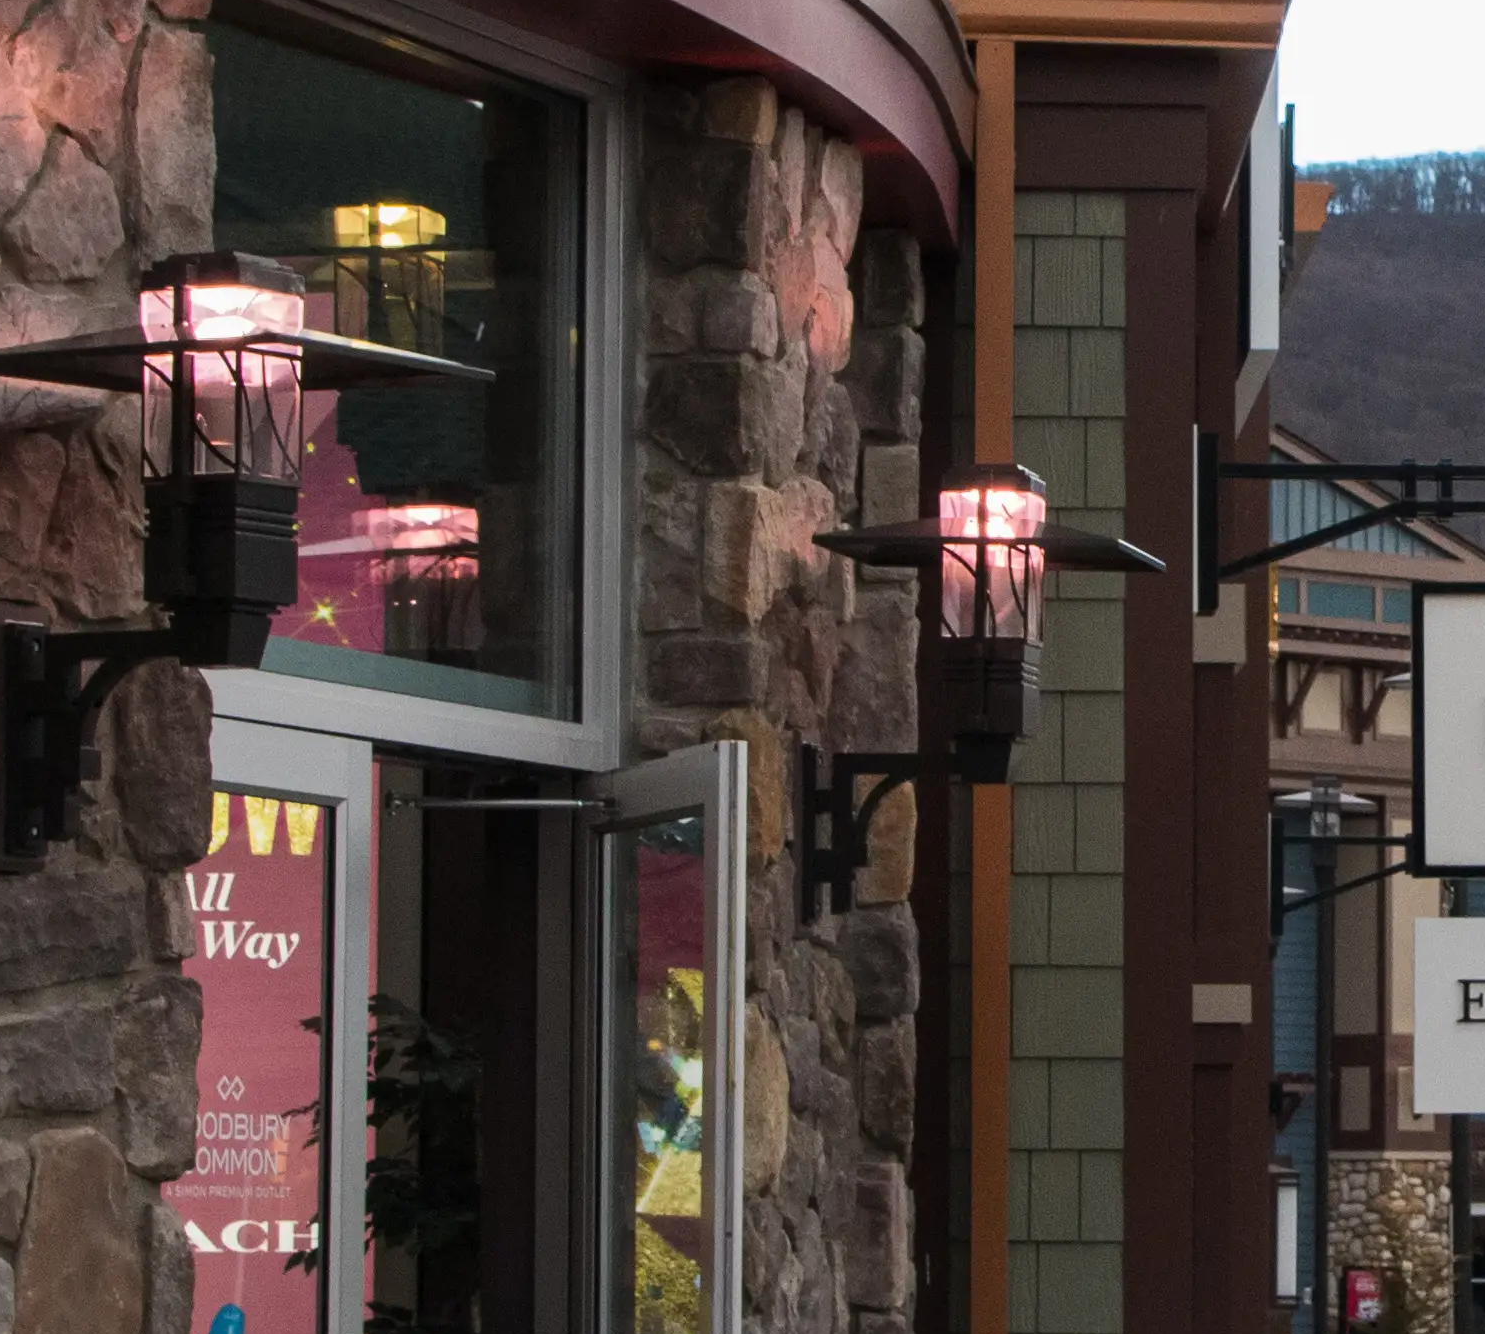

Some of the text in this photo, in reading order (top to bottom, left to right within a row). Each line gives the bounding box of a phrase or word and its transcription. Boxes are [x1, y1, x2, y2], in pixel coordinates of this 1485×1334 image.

[200, 919, 301, 970] Way
[194, 1110, 293, 1142] ODBURY
[185, 1146, 280, 1176] OMMON
